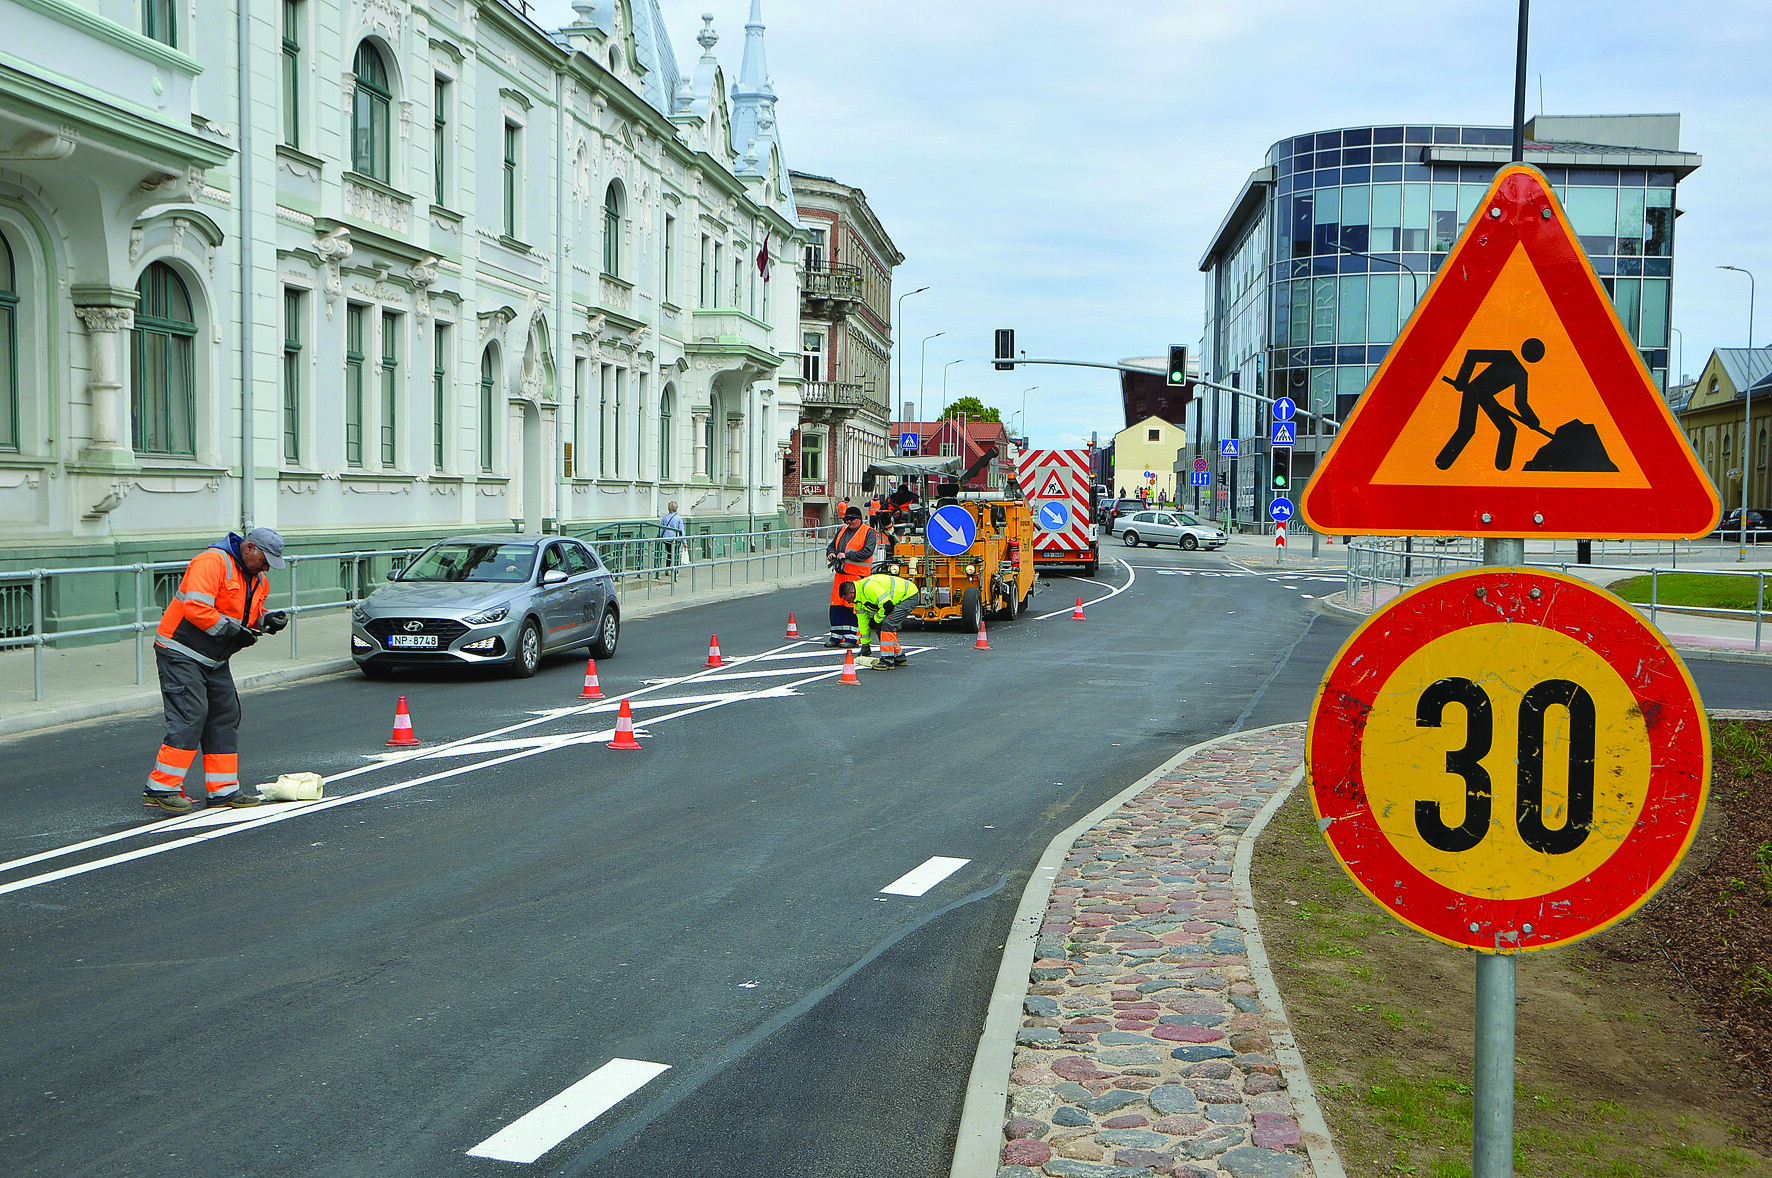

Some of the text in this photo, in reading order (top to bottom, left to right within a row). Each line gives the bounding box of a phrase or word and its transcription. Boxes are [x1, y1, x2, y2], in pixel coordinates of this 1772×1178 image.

[1291, 260, 1310, 387] GALLERY
[1314, 277, 1335, 408] GALLERY
[394, 636, 437, 646] NP-8748
[1414, 677, 1596, 855] 30
